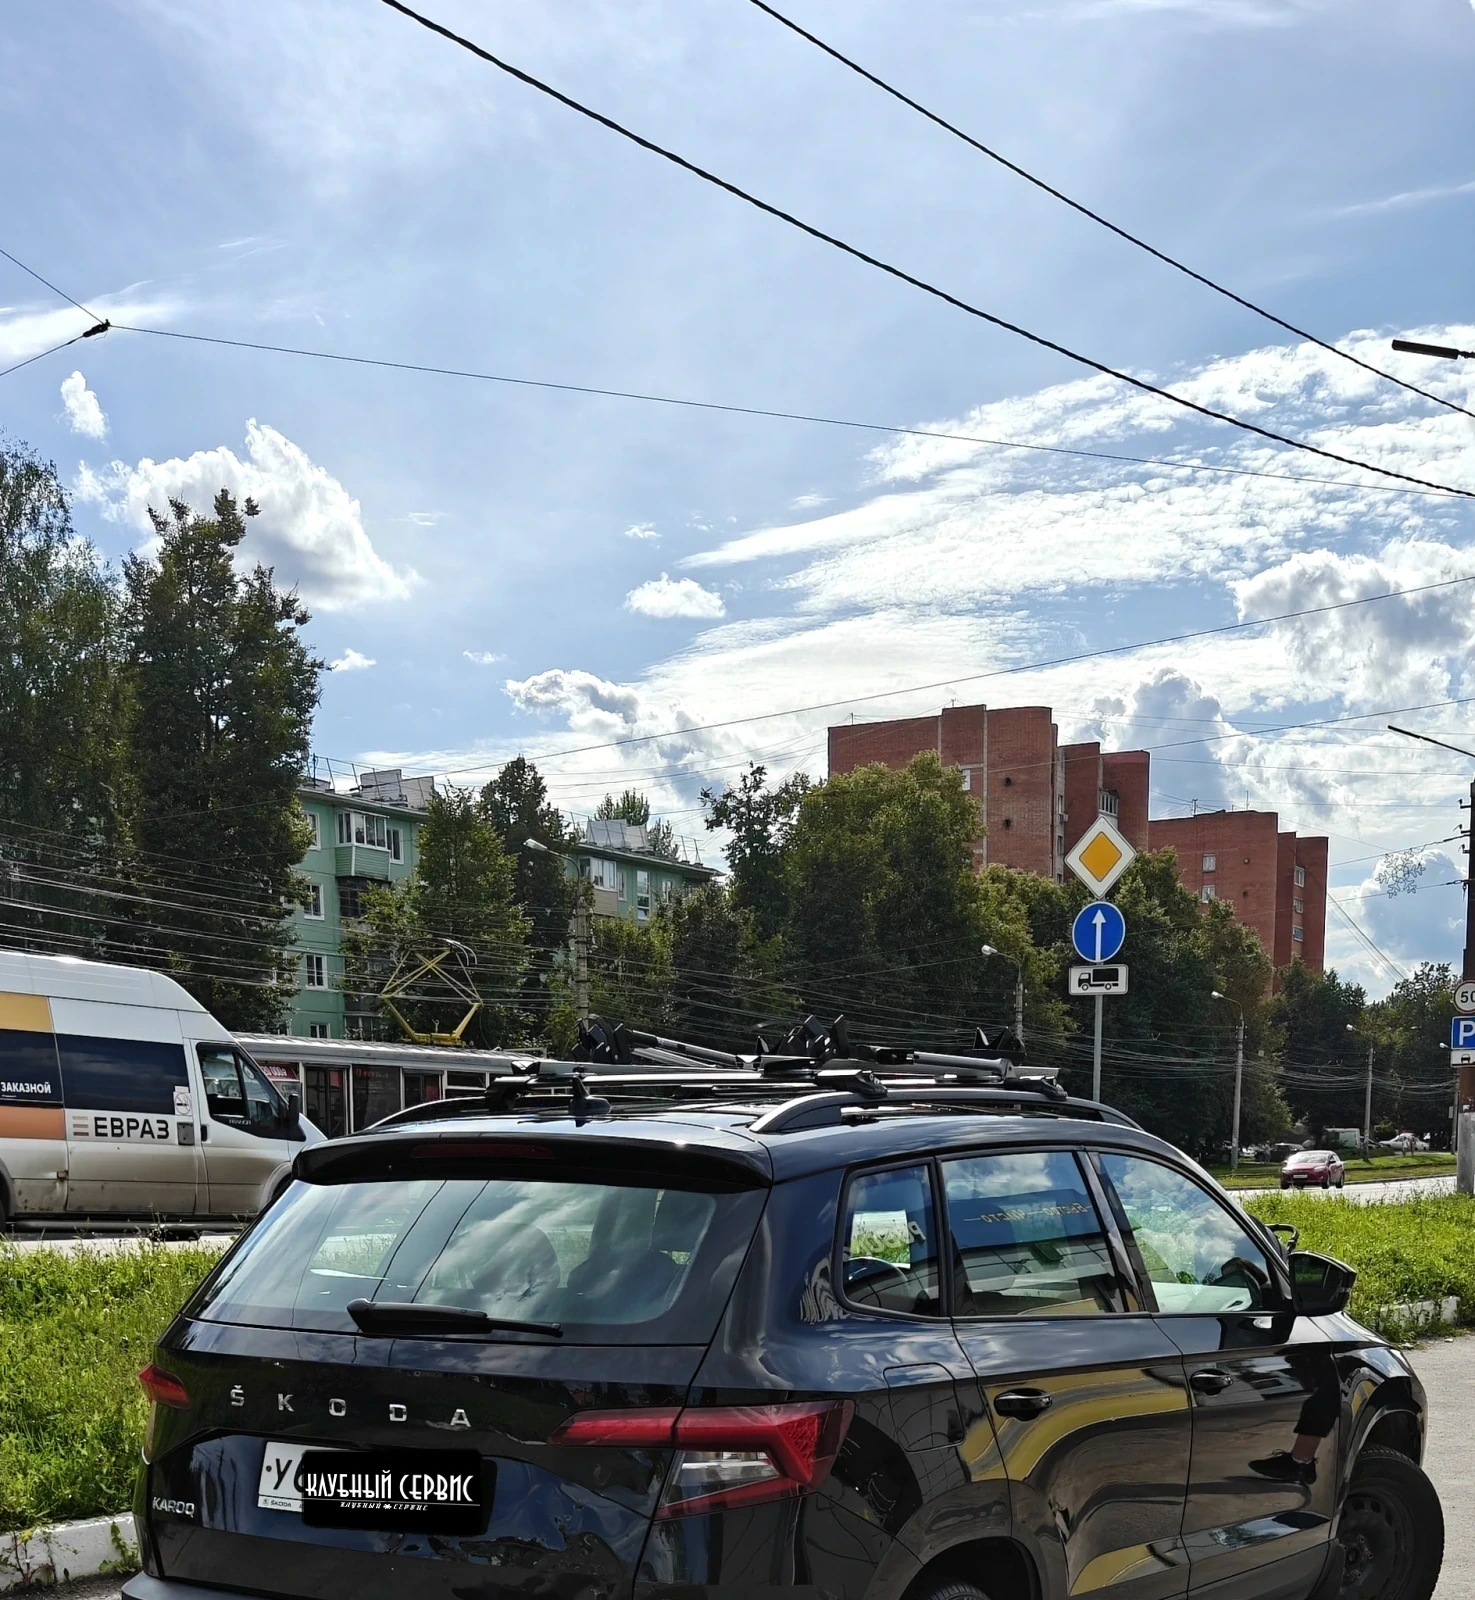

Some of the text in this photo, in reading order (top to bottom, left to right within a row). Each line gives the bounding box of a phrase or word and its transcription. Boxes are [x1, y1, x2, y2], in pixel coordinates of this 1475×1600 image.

[1458, 1020, 1475, 1046] P
[0, 1081, 52, 1094] ЗАКАЗНОЙ
[94, 1116, 170, 1140] ЕВРАЗ
[230, 1384, 472, 1429] ŠKODA
[152, 1496, 195, 1518] KAROQ
